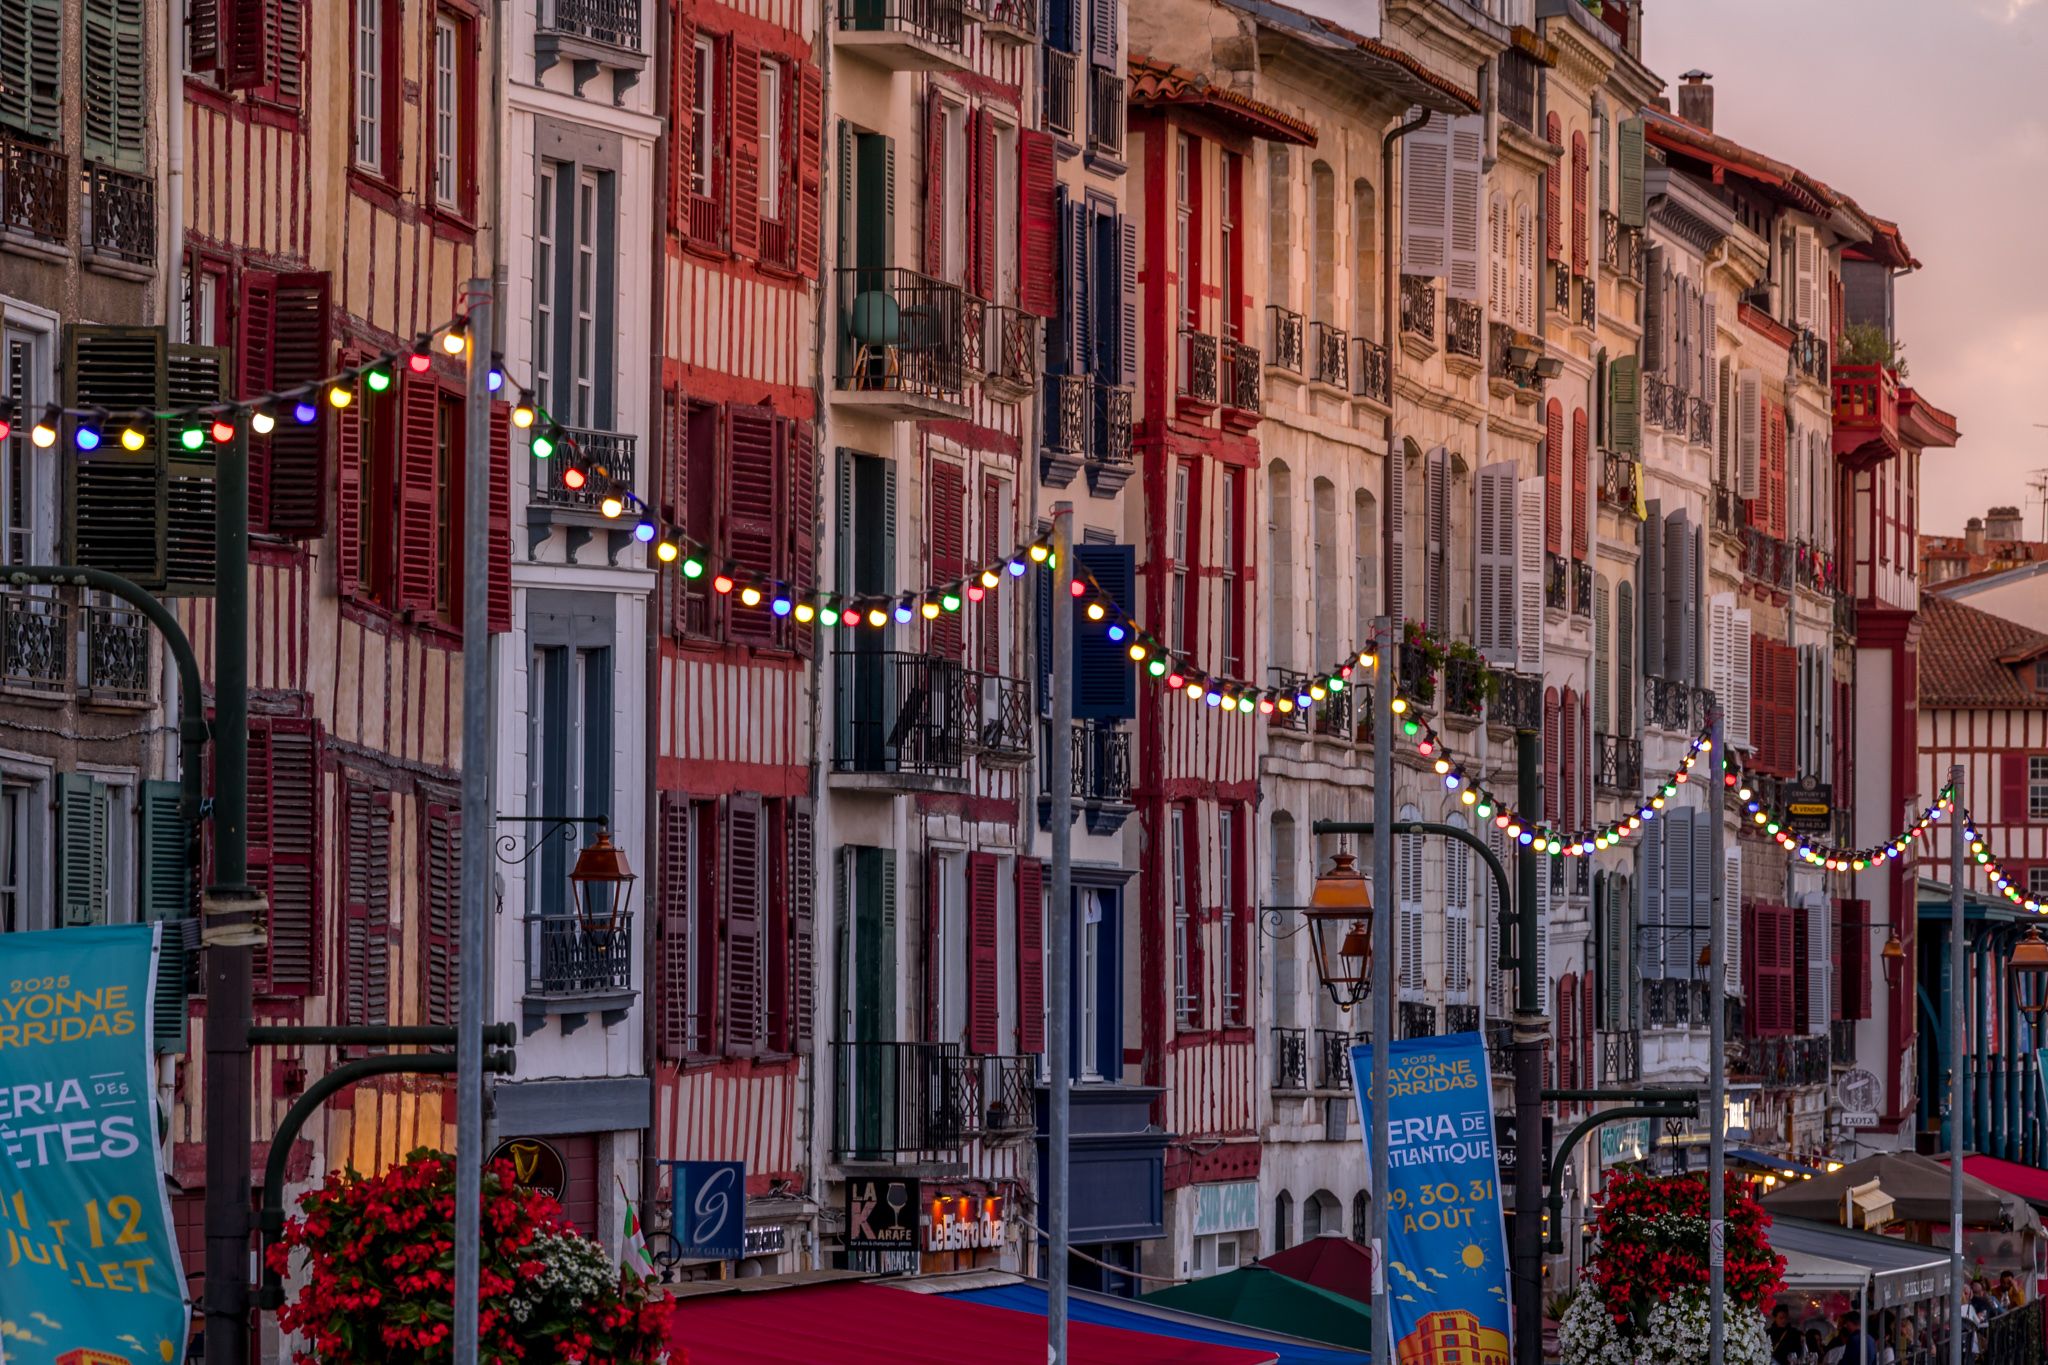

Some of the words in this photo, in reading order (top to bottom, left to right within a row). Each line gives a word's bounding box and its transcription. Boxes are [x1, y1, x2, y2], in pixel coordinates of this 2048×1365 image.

[10, 975, 71, 994] 2025
[0, 985, 128, 1022] YONNE
[1370, 1060, 1472, 1086] AYONNE
[1402, 1055, 1436, 1065] 2025
[93, 1082, 130, 1096] DES
[1371, 1114, 1458, 1147] ERIA
[1461, 1116, 1486, 1132] DE
[852, 1182, 877, 1201] LA
[1420, 1183, 1465, 1205] 30,
[1470, 1179, 1493, 1200] 31
[48, 1219, 71, 1246] T
[85, 1195, 148, 1248] 12
[929, 1215, 943, 1251] Le
[943, 1213, 979, 1251] Bistro
[1404, 1205, 1475, 1234] AOÛT
[6, 1228, 154, 1294] JUILET
[704, 1247, 740, 1257] GILLES
